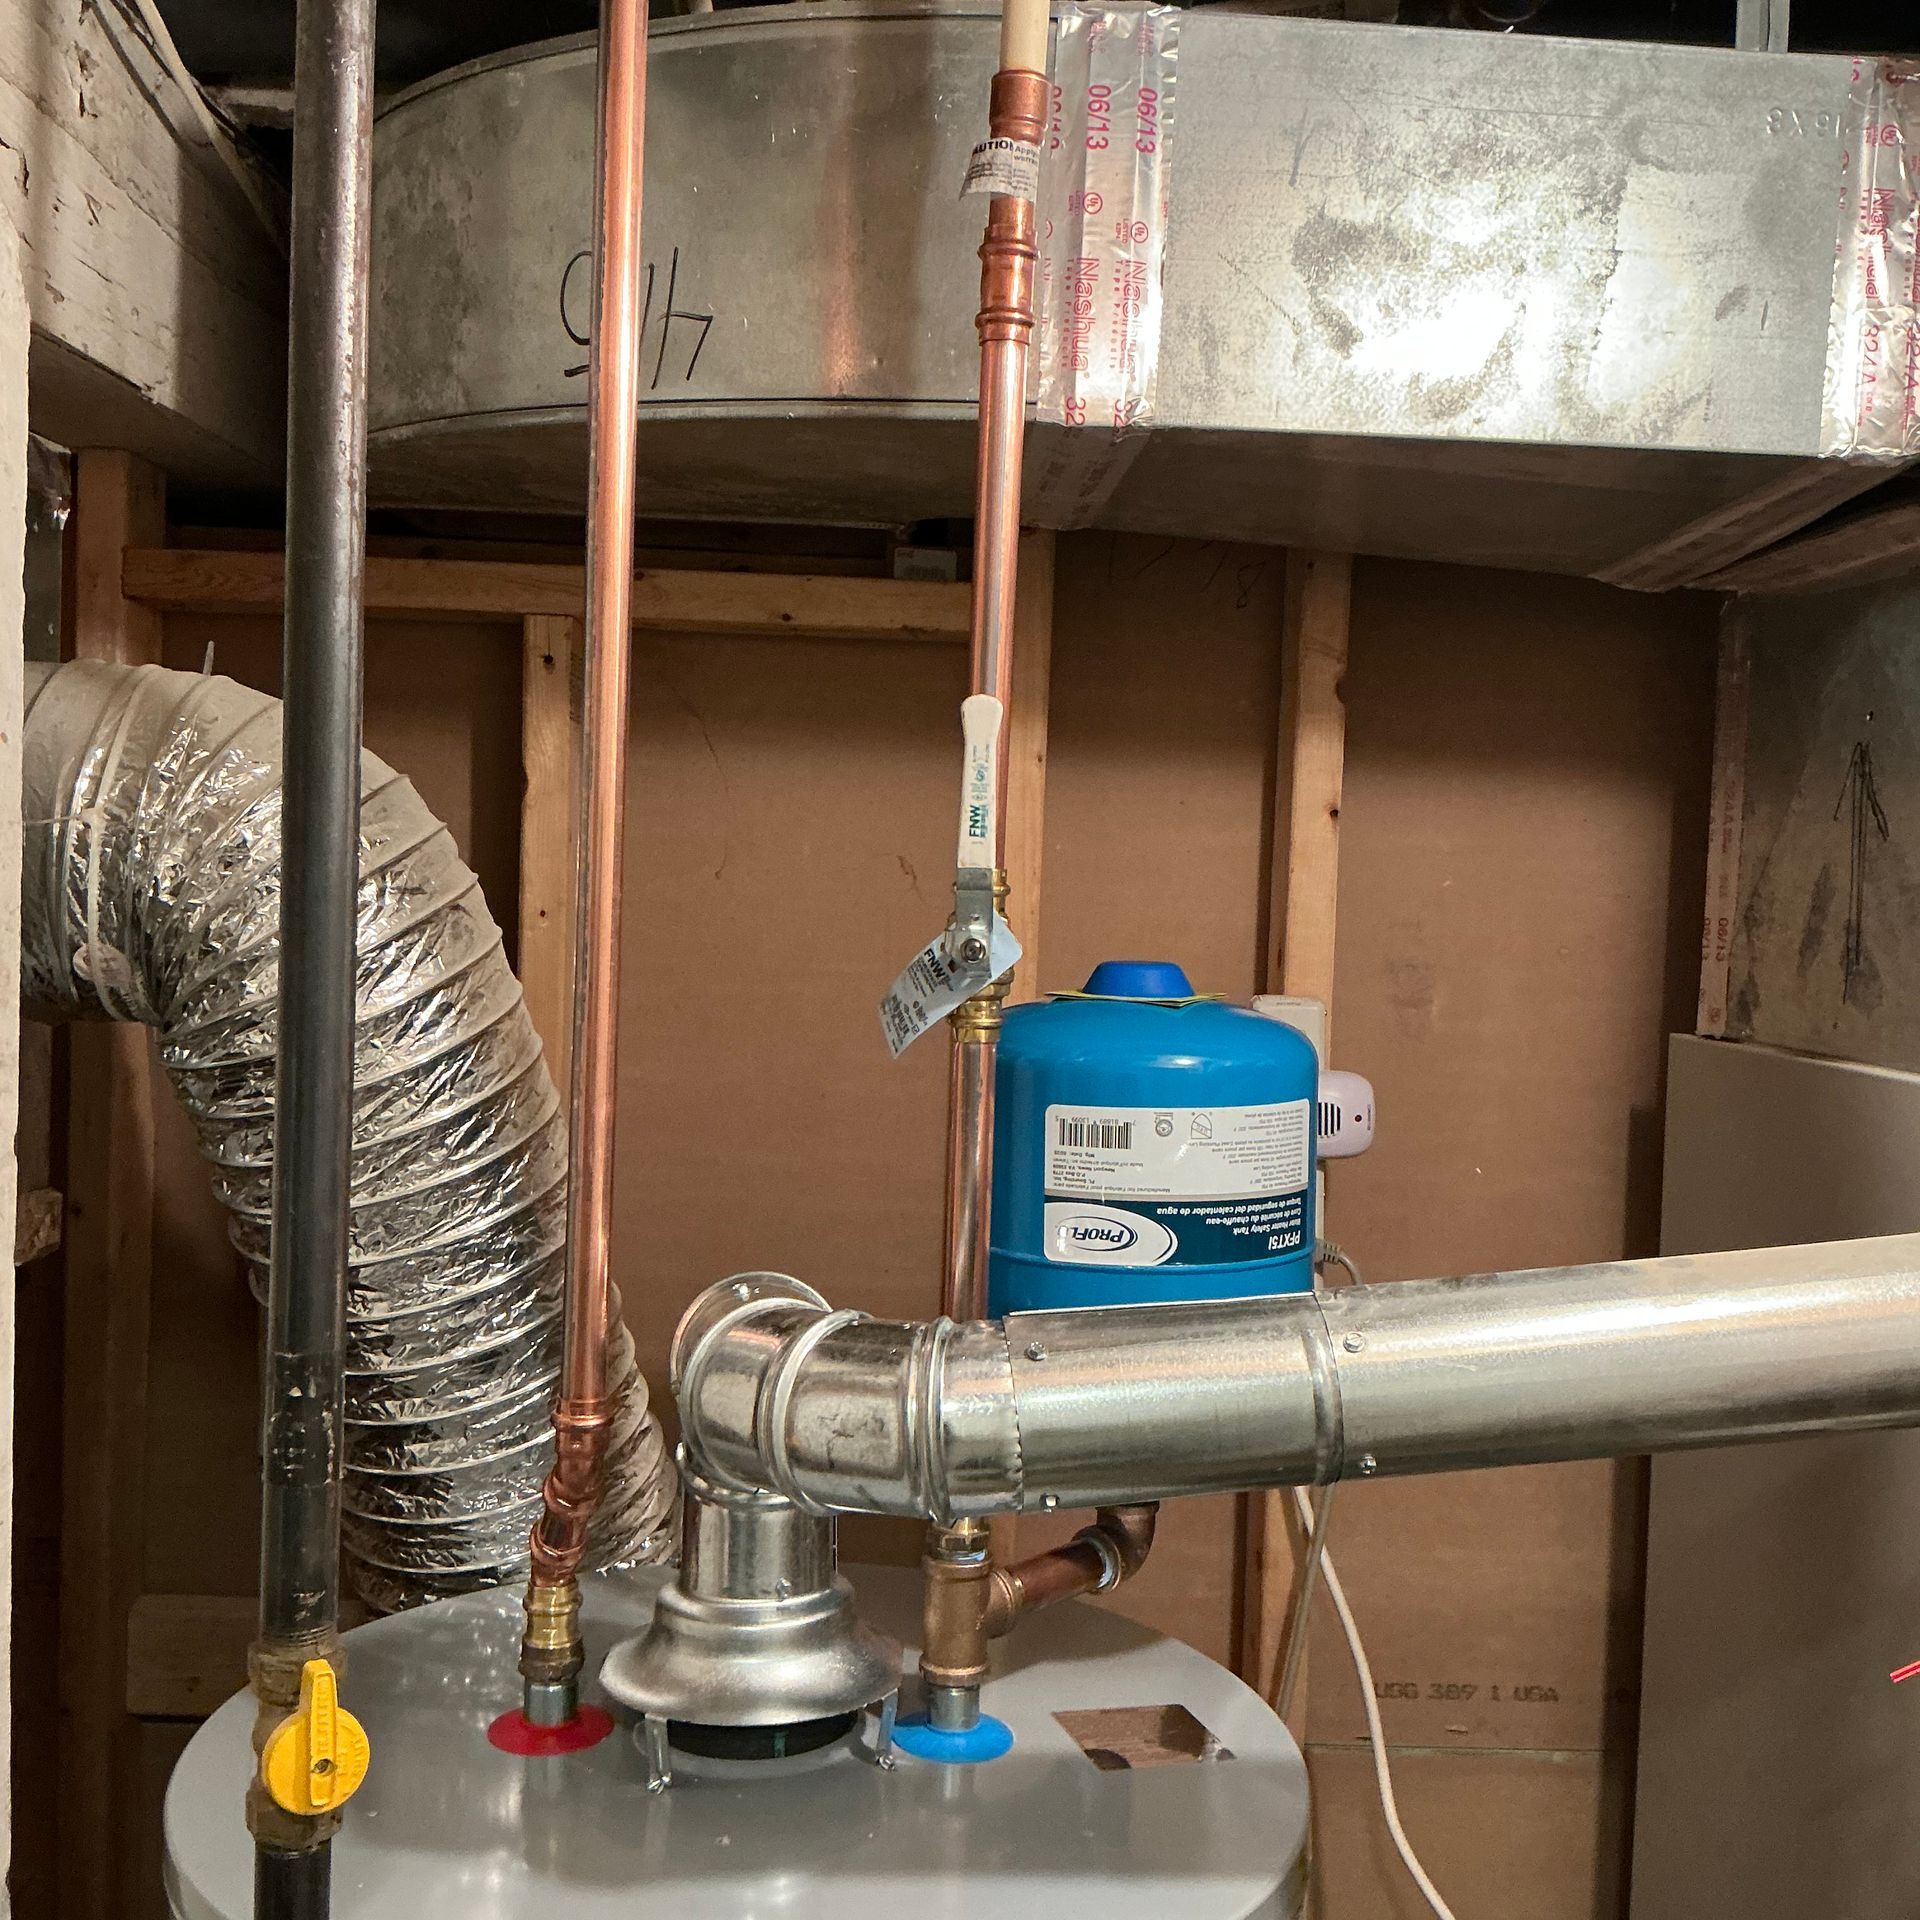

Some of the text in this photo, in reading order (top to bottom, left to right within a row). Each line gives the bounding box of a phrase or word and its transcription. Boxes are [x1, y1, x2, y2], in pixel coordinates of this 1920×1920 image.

[1086, 85, 1111, 150] 06/13
[1136, 88, 1158, 154] 06/13
[968, 804, 981, 838] FNW
[924, 948, 946, 978] FNW
[1156, 1206, 1178, 1215] agua
[1179, 1207, 1191, 1216] de
[1192, 1206, 1234, 1216] calentador
[1235, 1206, 1246, 1214] del
[1247, 1201, 1278, 1213] seguridad
[1205, 1215, 1249, 1225] chauffe-eau
[1251, 1215, 1259, 1223] du
[1233, 1226, 1249, 1236] Tank
[1250, 1224, 1271, 1233] Safety
